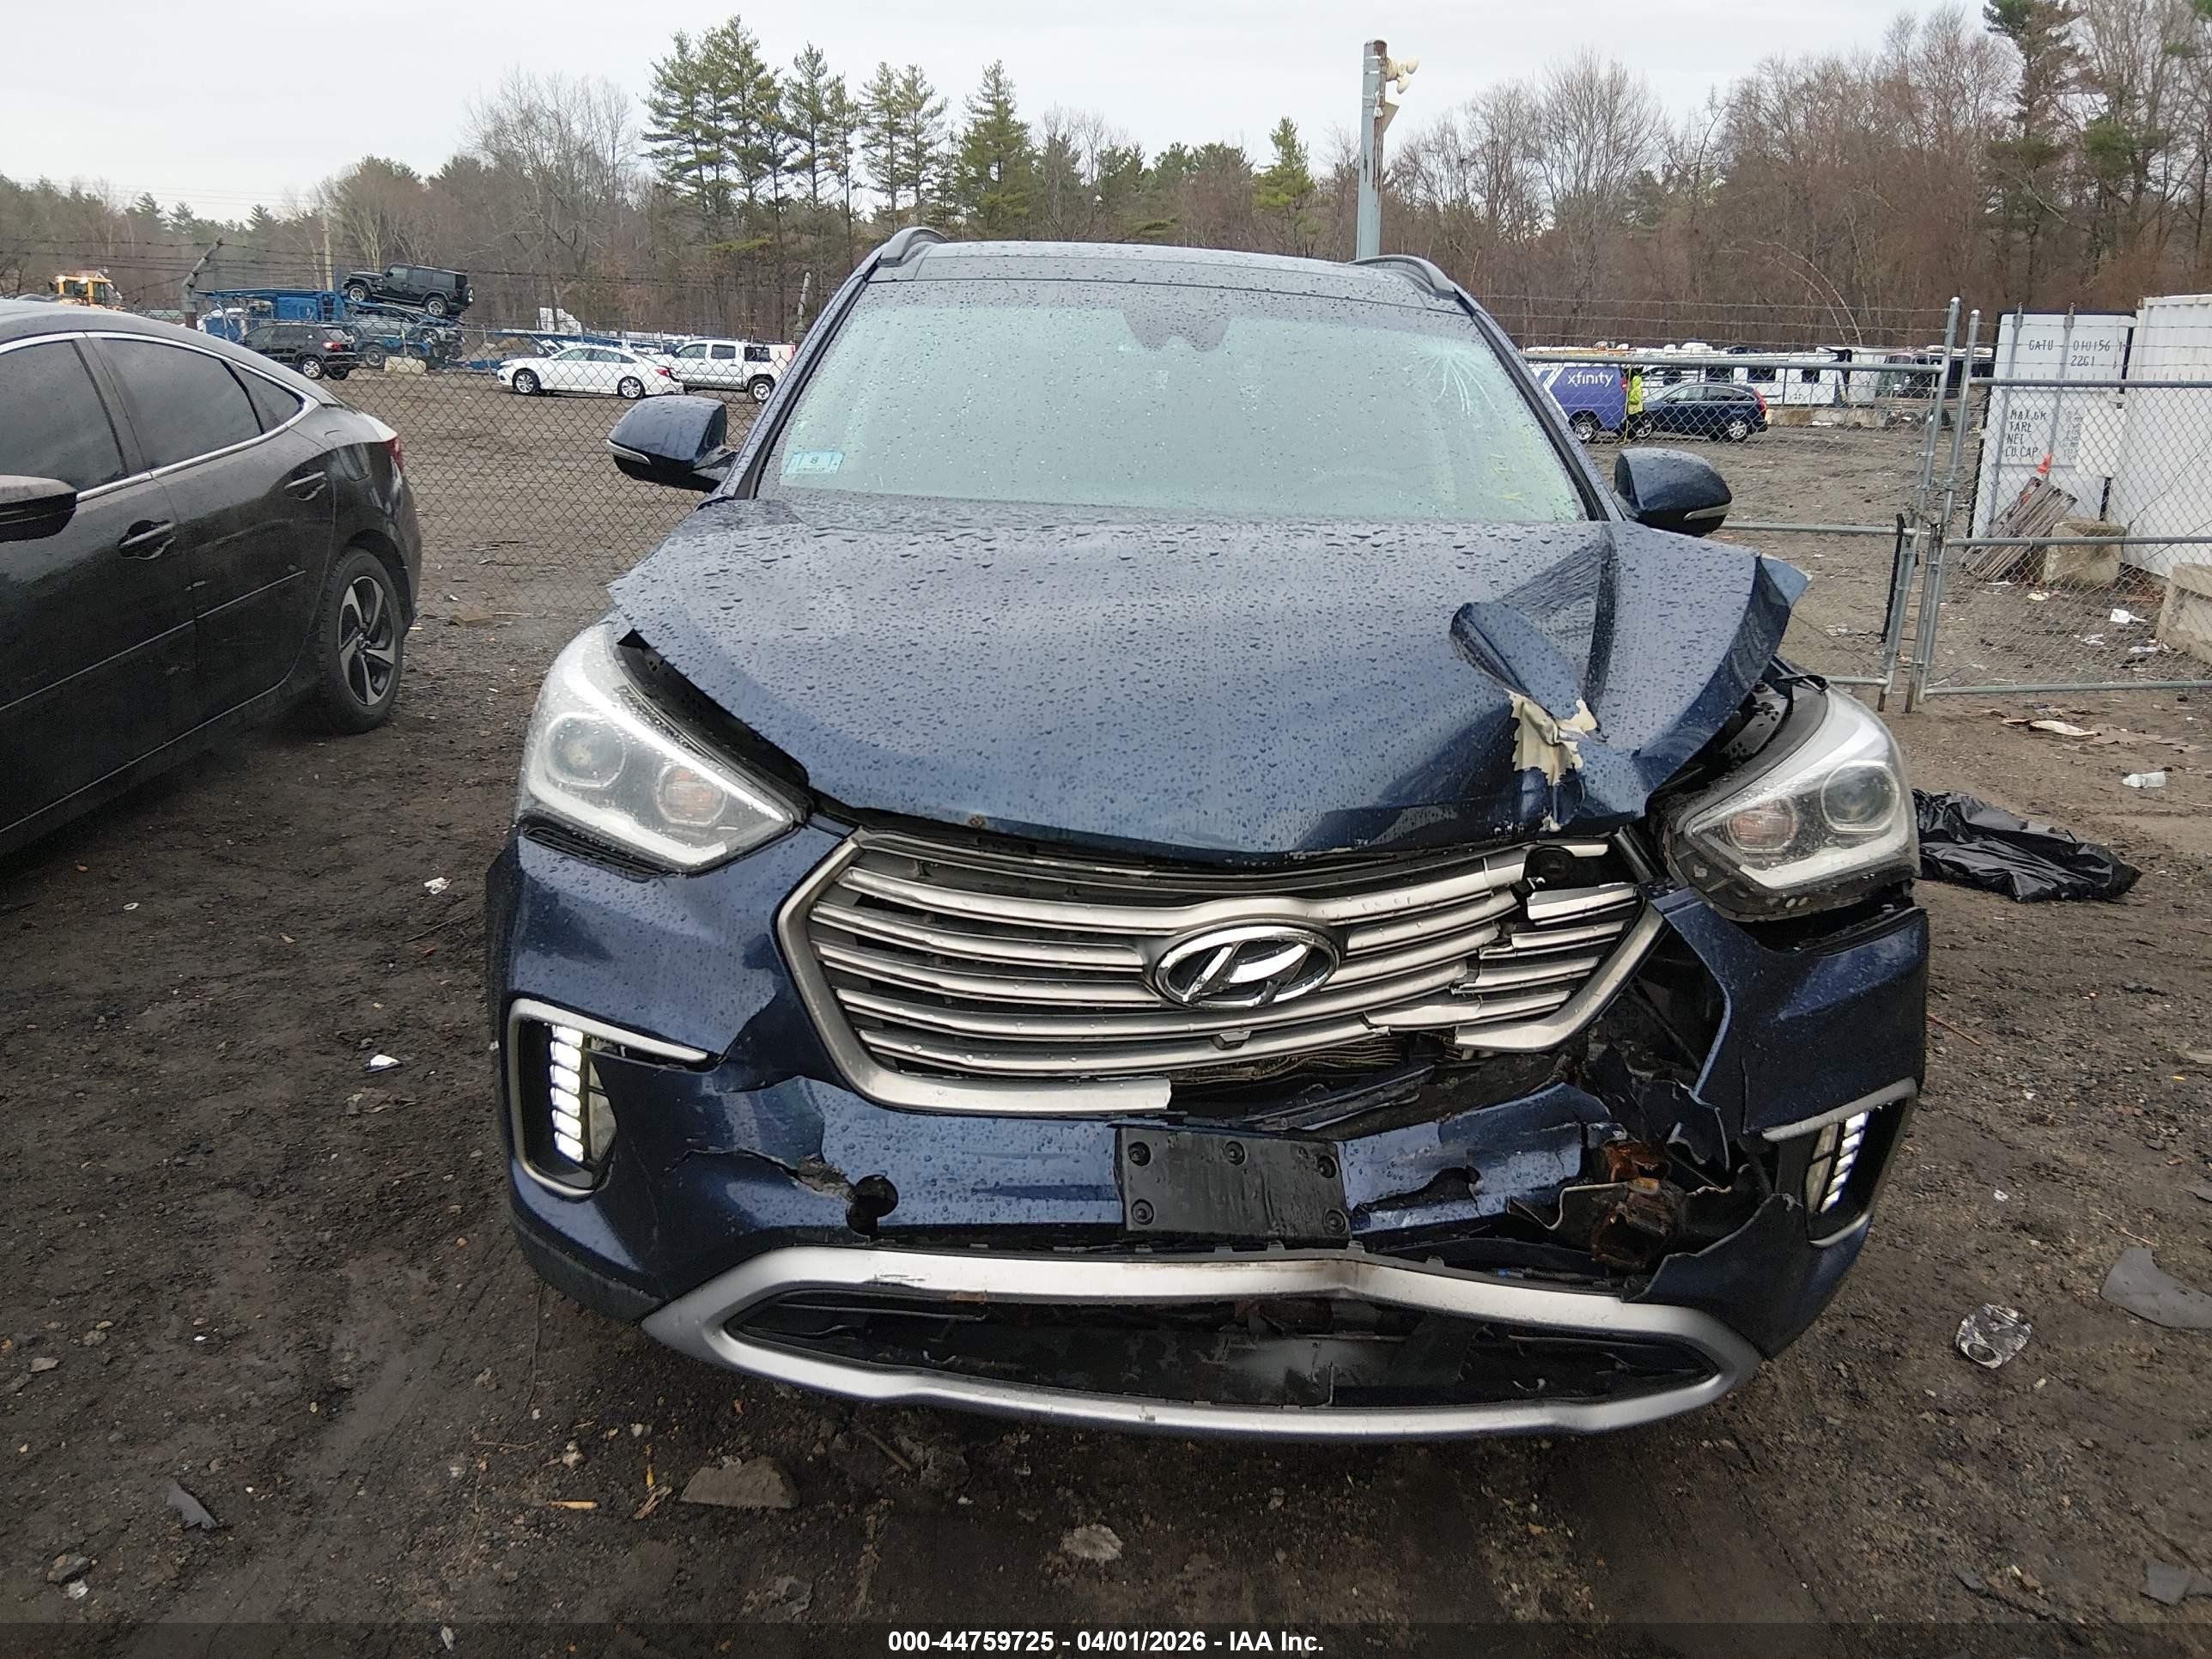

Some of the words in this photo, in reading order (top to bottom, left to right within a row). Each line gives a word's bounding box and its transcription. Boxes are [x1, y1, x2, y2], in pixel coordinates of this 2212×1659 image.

[2028, 339, 2054, 350] GATU
[2073, 339, 2111, 351] 010156
[1567, 370, 1613, 388] xfinity
